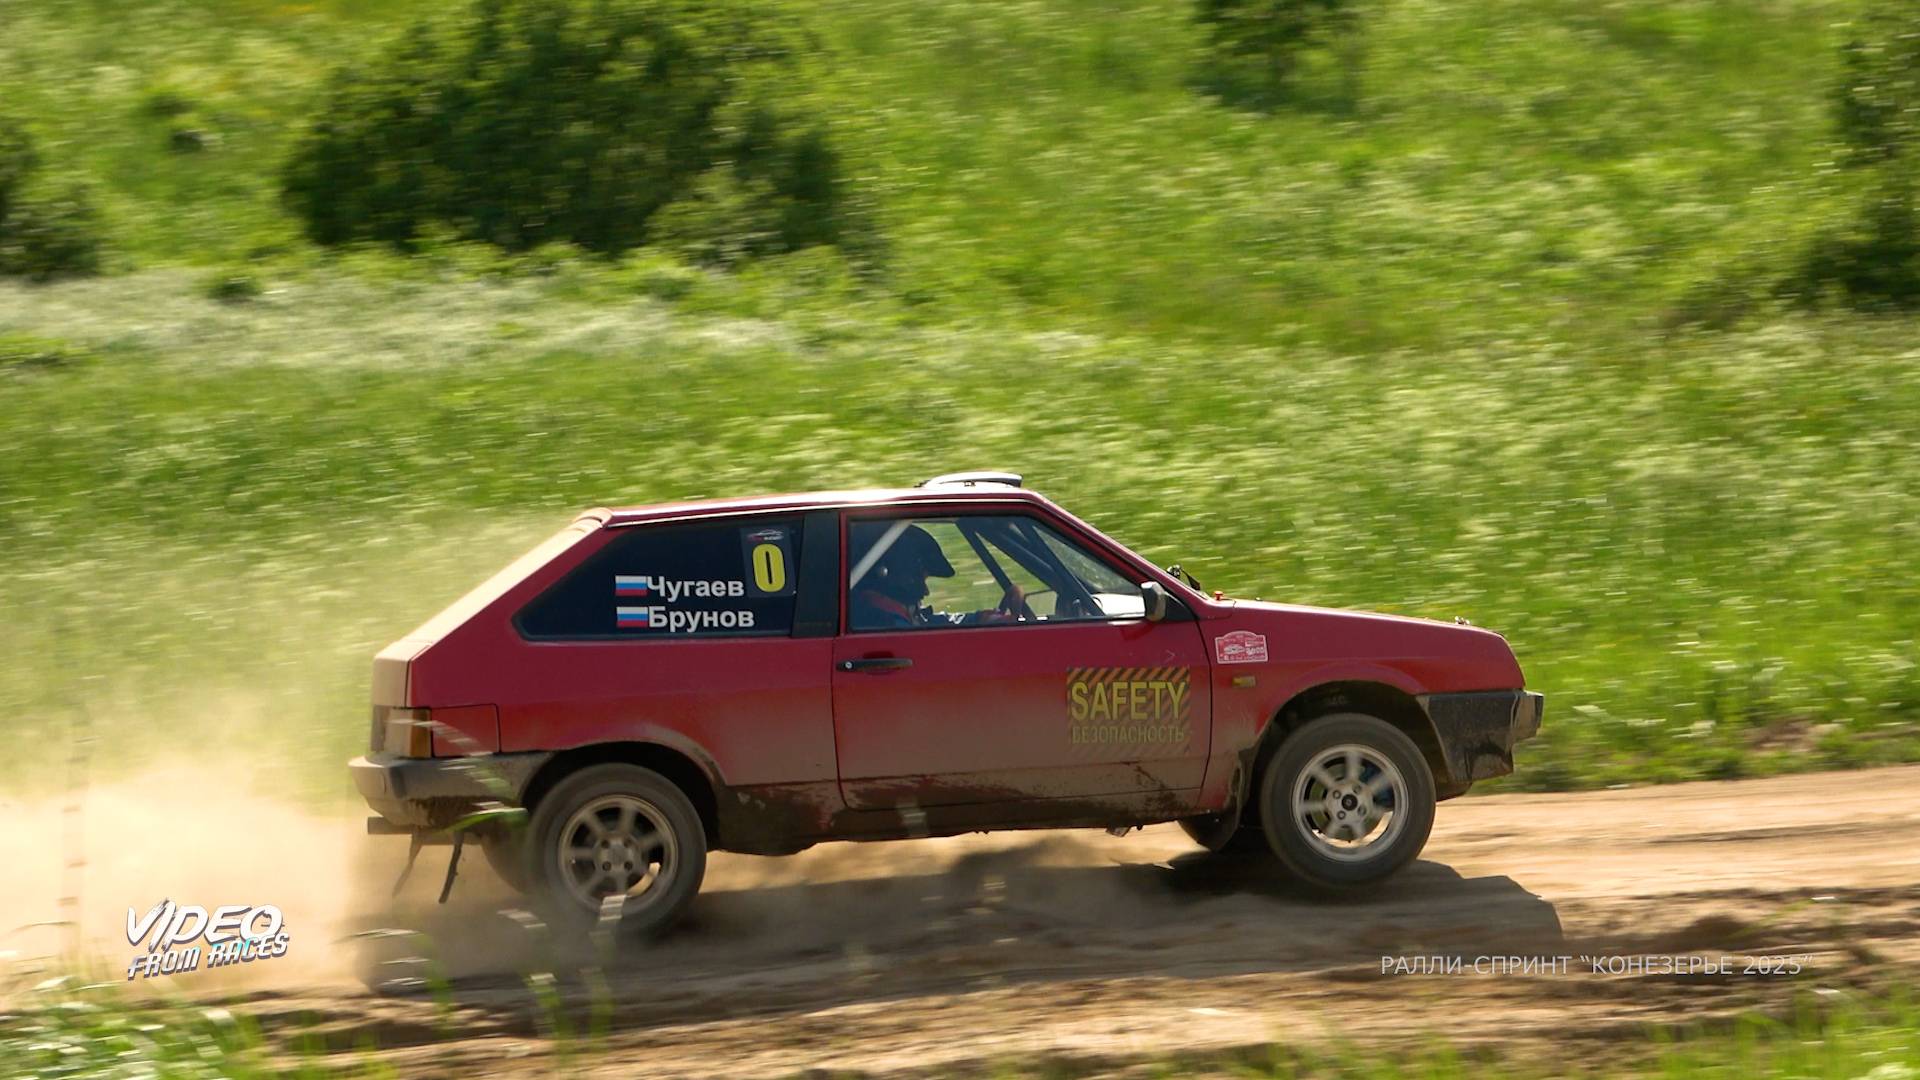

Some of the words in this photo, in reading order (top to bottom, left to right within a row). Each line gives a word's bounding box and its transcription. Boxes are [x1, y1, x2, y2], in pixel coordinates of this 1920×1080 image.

[753, 543, 786, 593] 0
[647, 576, 745, 602] Чугаев
[649, 606, 755, 632] Брунов
[1071, 681, 1186, 721] SAFETY
[1072, 725, 1185, 744] БЕЗОПАСНОСТЬ
